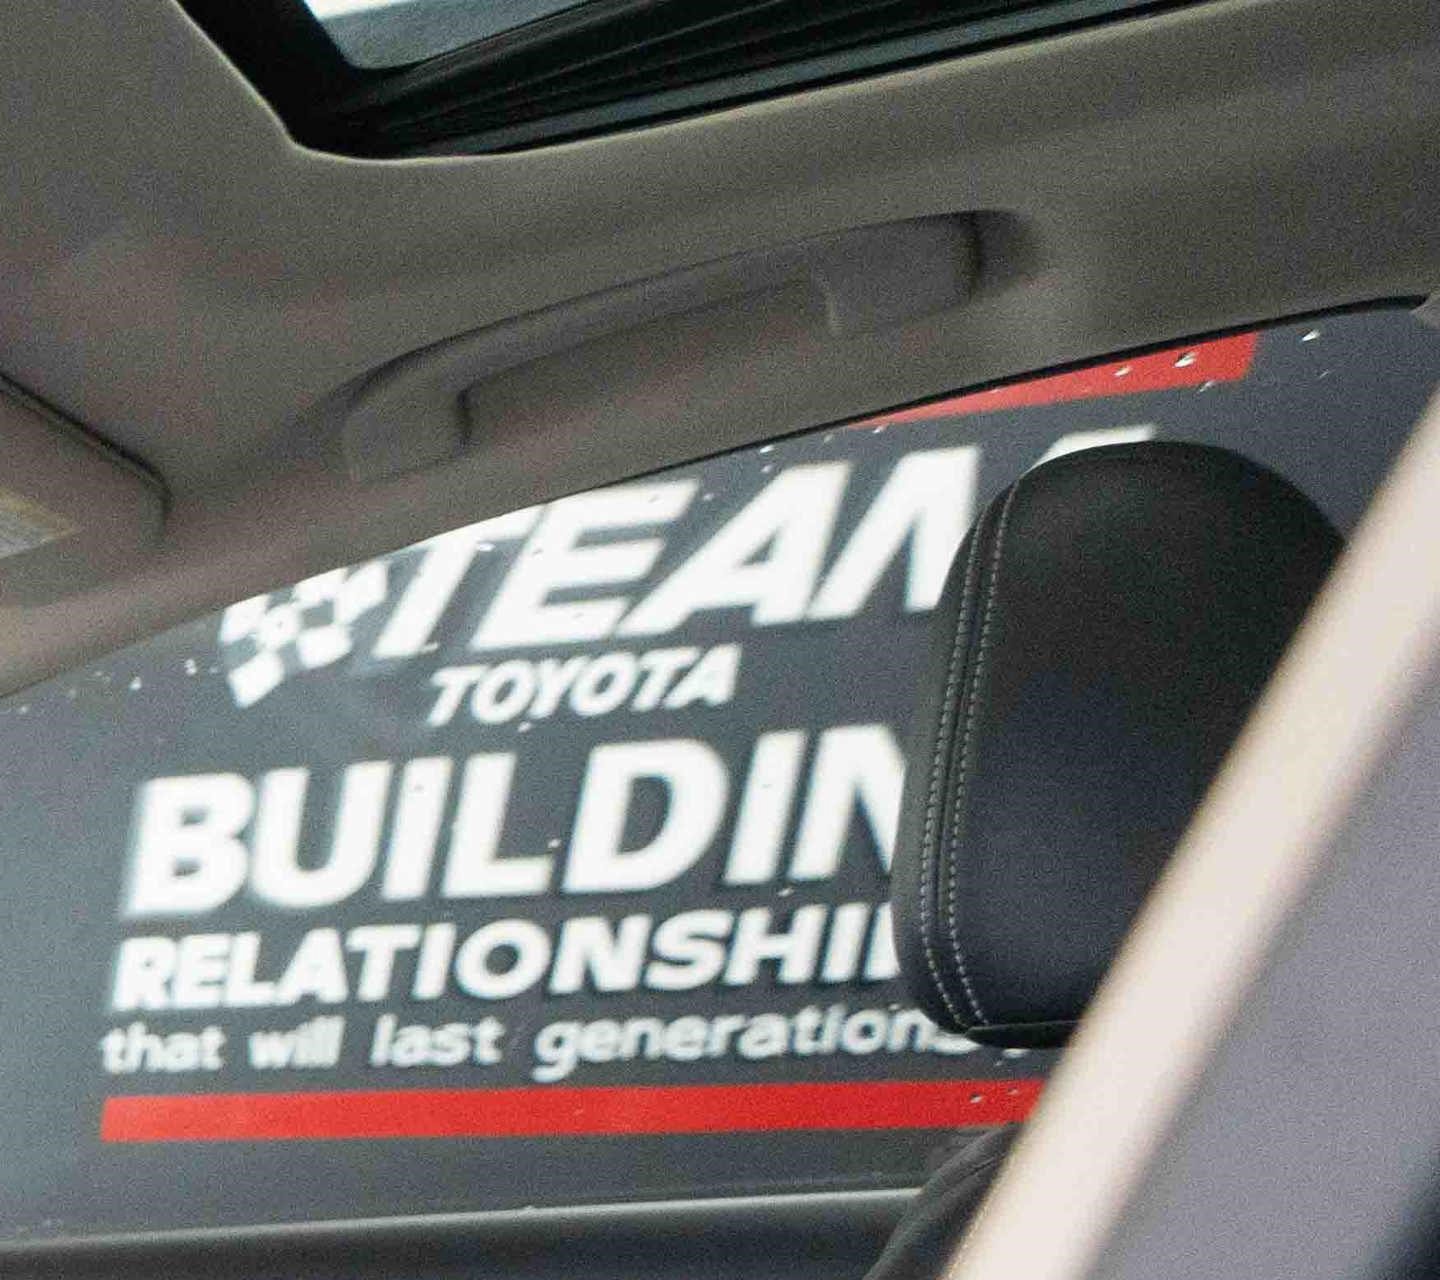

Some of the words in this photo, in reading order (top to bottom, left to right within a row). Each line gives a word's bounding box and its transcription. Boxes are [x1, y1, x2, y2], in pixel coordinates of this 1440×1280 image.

[427, 645, 741, 727] TOYOTA
[101, 1022, 223, 1075] that
[247, 1015, 345, 1070] will
[371, 1012, 504, 1067] last
